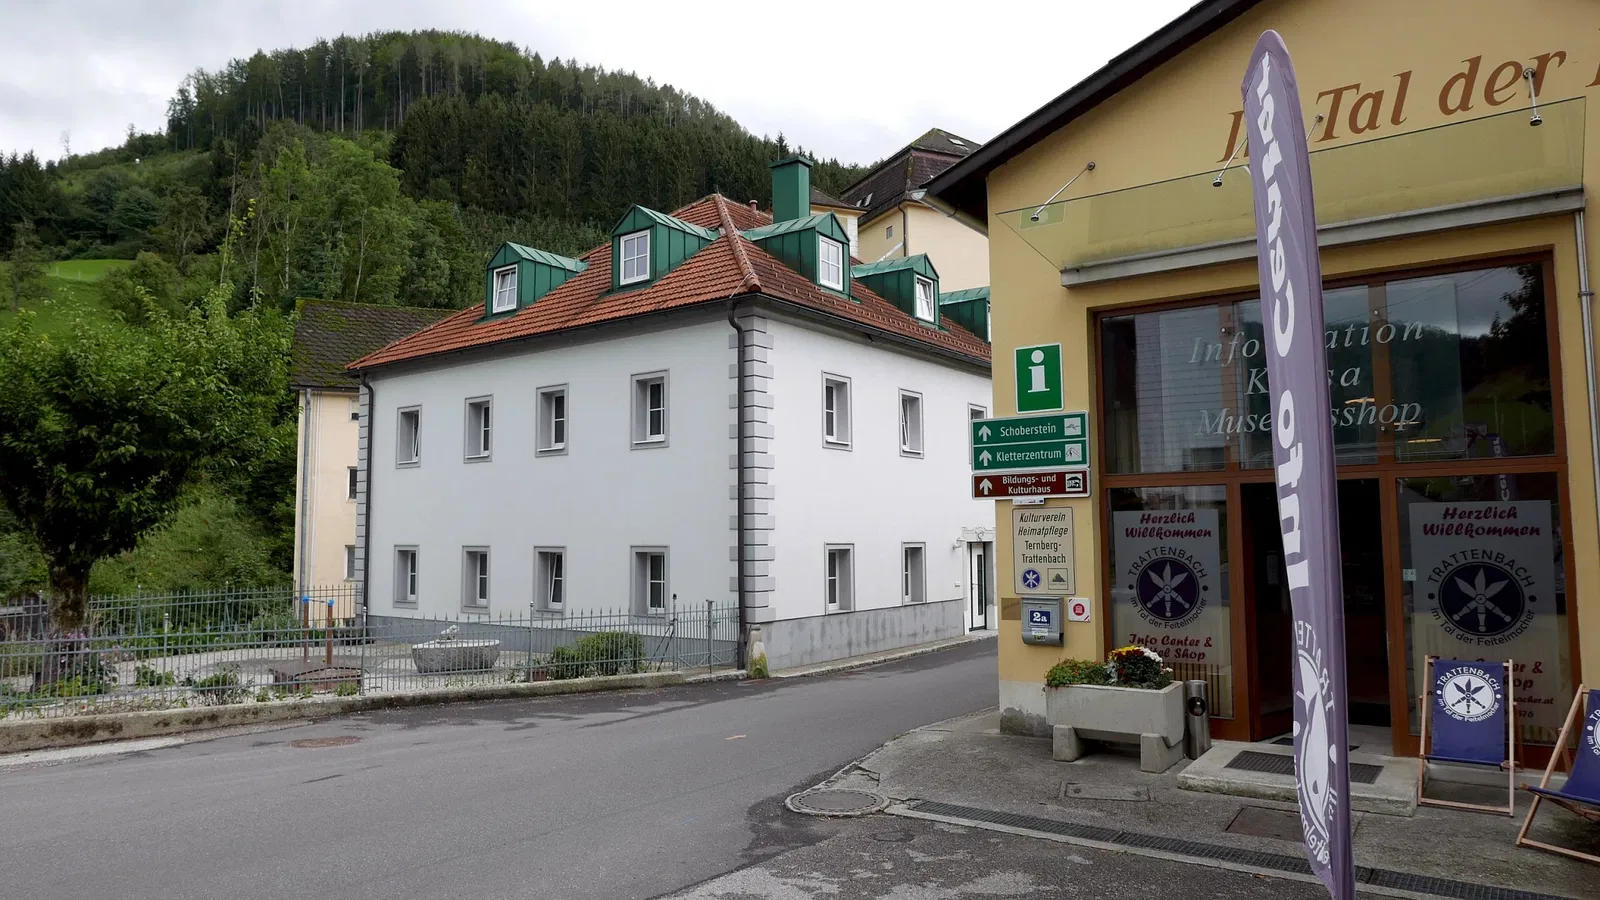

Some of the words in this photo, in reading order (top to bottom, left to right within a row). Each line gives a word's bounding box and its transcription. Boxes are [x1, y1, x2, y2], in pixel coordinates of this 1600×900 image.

[1314, 70, 1412, 143] Tal
[1438, 50, 1566, 116] der
[1189, 321, 1423, 367] Infoation
[1194, 396, 1421, 436] Musesshop
[1000, 423, 1057, 437] Schoberstein
[996, 449, 1062, 462] Kletterzentrum
[1002, 475, 1039, 485] Bildungs-
[1041, 474, 1057, 483] und
[1008, 485, 1051, 495] Kulturhaus
[1019, 512, 1067, 522] Kulturverein
[1140, 512, 1195, 524] Herzlich
[1443, 506, 1519, 520] Herzlich
[1017, 526, 1069, 538] Heimatpflege
[1125, 527, 1212, 540] Willkommen
[1423, 523, 1541, 538] Willkommen
[1024, 540, 1062, 552] Ternberg-
[1021, 553, 1067, 564] Trattenbach
[1128, 546, 1208, 579] TRATTENBACH
[1427, 548, 1536, 588] TRATTENBACH
[1032, 611, 1048, 622] 2a
[1137, 608, 1149, 619] Tal
[1148, 618, 1163, 628] der
[1164, 597, 1207, 629] Feitelmacher
[1430, 607, 1441, 621] im
[1440, 619, 1455, 636] Tal
[1456, 632, 1475, 644] der
[1477, 609, 1535, 646] Feitelmacher
[1128, 633, 1157, 647] Info
[1161, 635, 1200, 647] Center
[1203, 636, 1213, 648] &
[1174, 648, 1206, 661] Shop
[1531, 660, 1544, 674] &
[1436, 666, 1501, 691] TRATTENBACH
[1443, 706, 1453, 716] Tal
[1451, 712, 1464, 721] der
[1464, 702, 1500, 722] Feitelmacher
